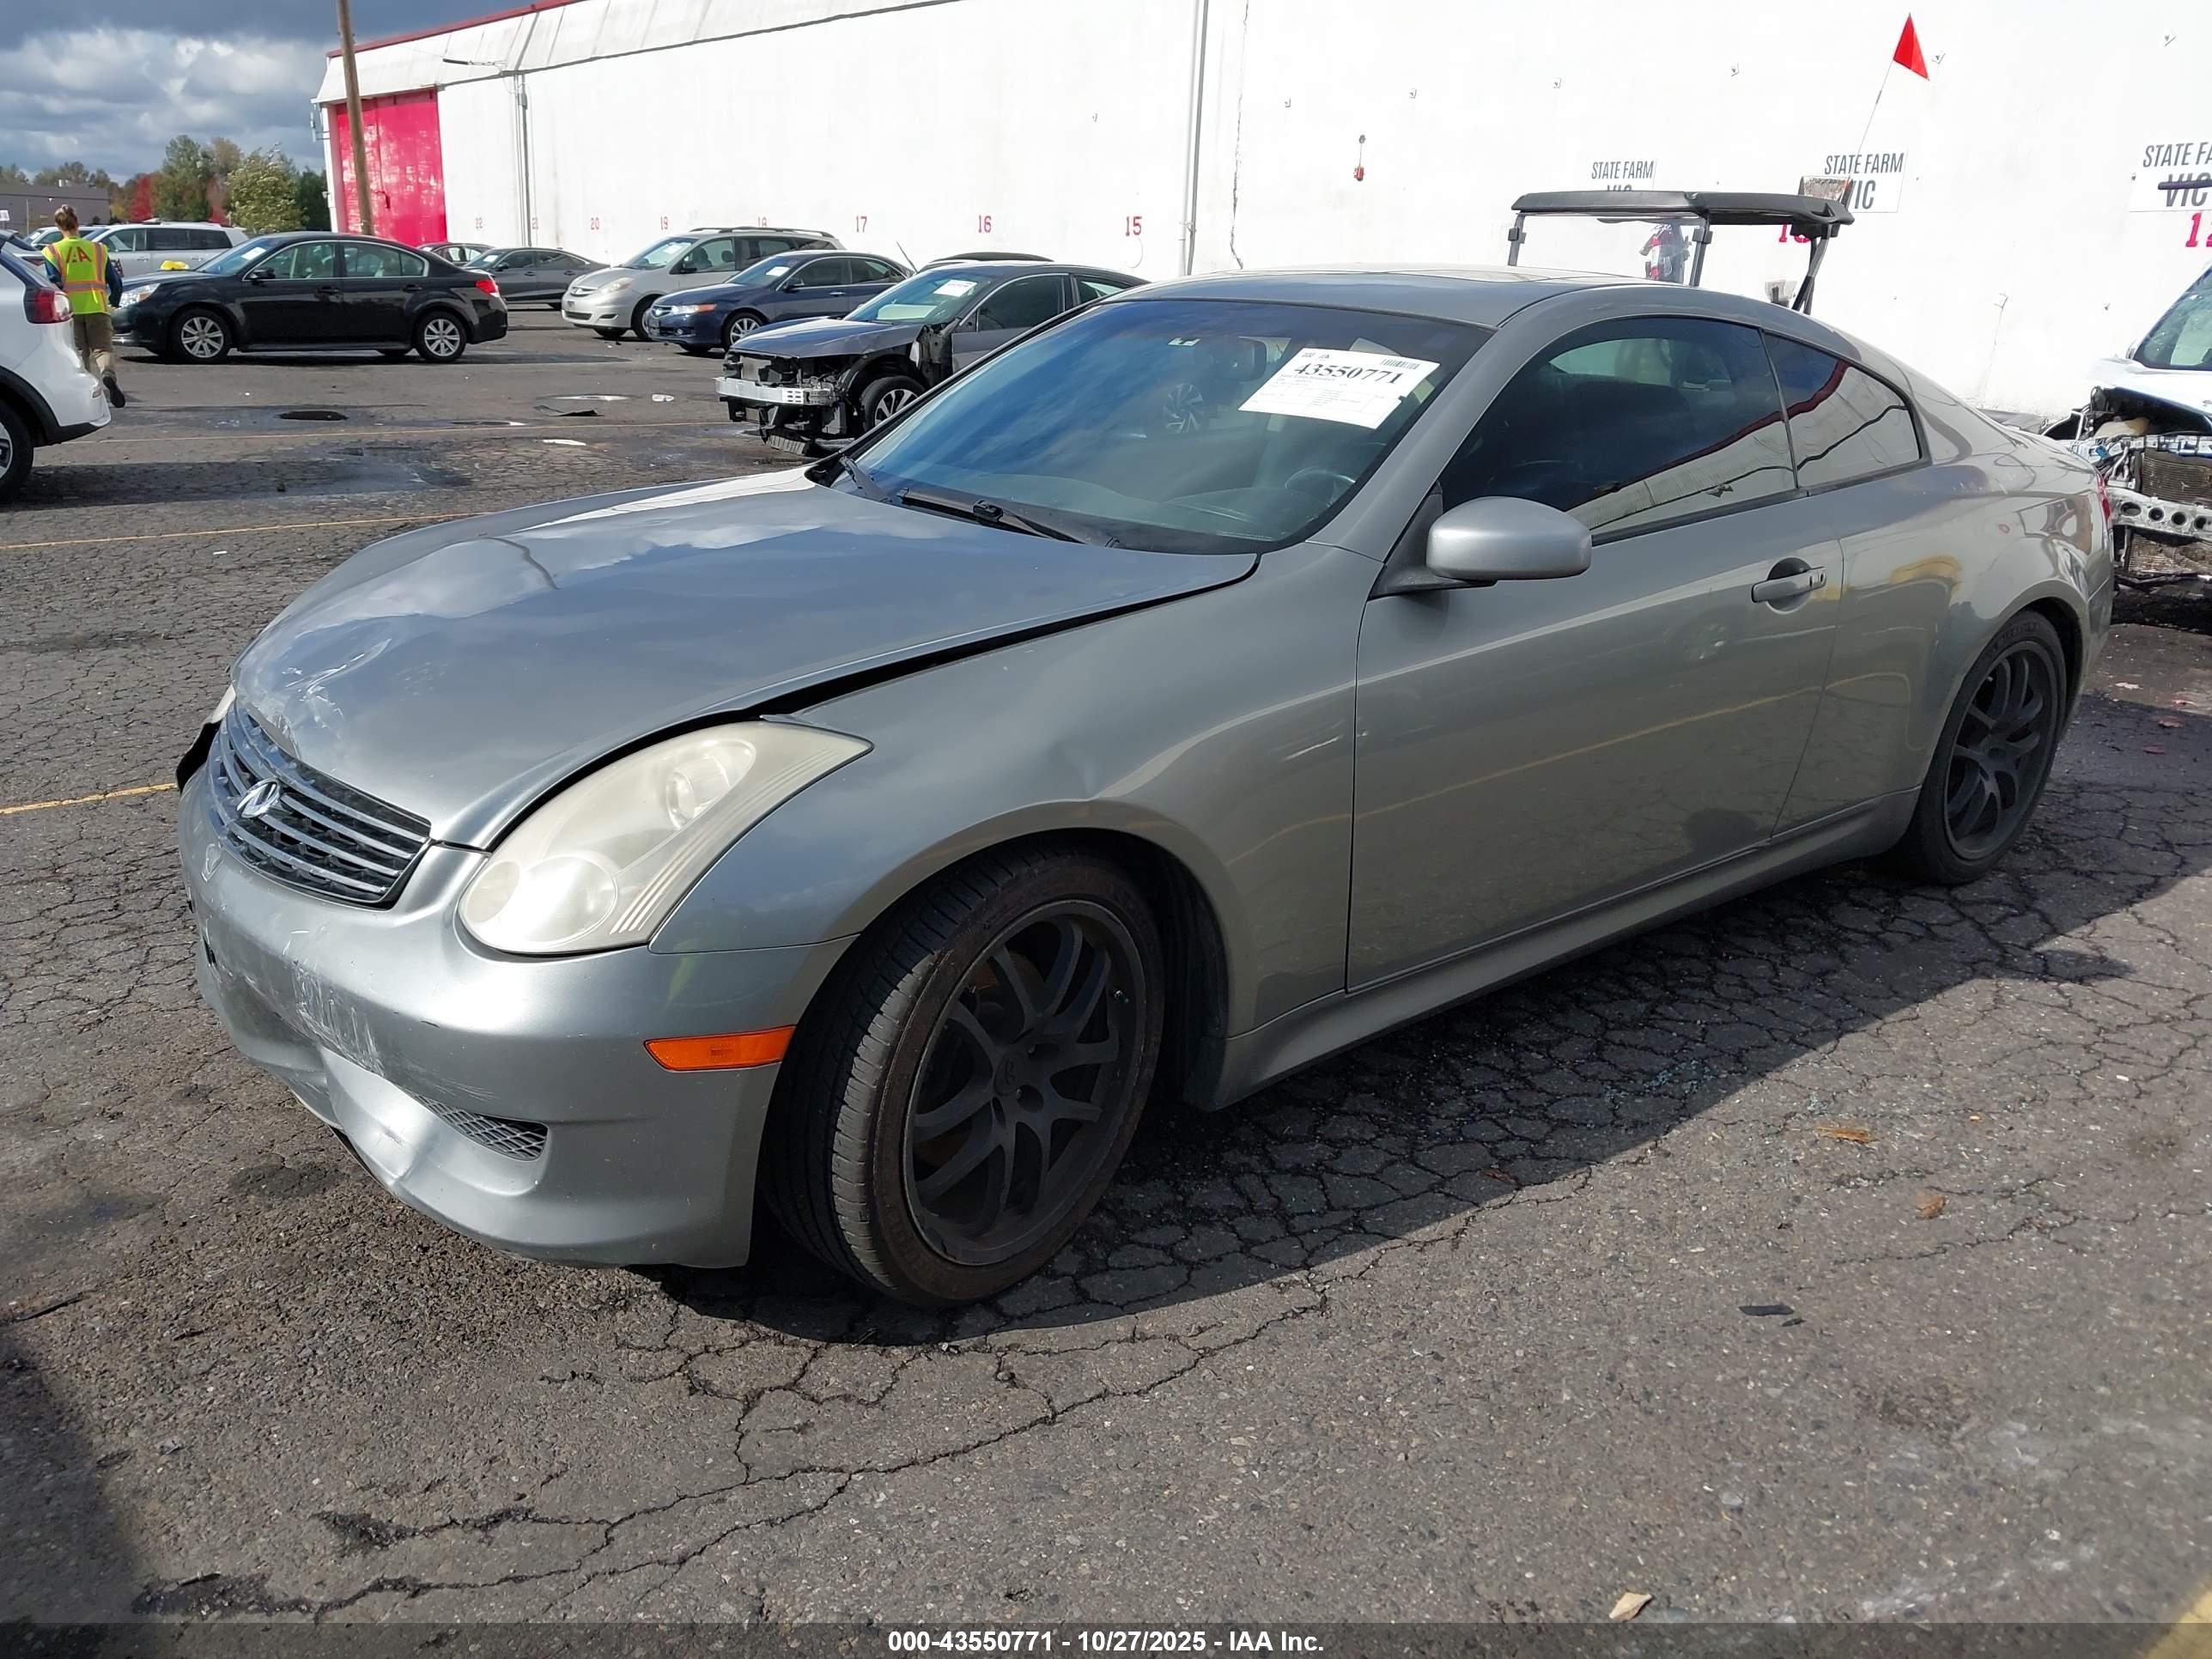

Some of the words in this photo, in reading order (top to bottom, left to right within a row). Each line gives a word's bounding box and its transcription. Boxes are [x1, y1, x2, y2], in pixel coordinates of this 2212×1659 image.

[1825, 155, 1862, 174] STATE
[1864, 153, 1904, 173] FARM
[2143, 143, 2194, 167] STATE
[1591, 161, 1621, 179] STATE
[1623, 161, 1654, 179] FARM
[1851, 179, 1876, 210] IC
[590, 216, 600, 230] 20
[855, 216, 867, 233] 17
[978, 215, 992, 234] 16
[1125, 216, 1143, 236] 15
[2185, 212, 2212, 247] 1
[1294, 362, 1404, 385] 43550771
